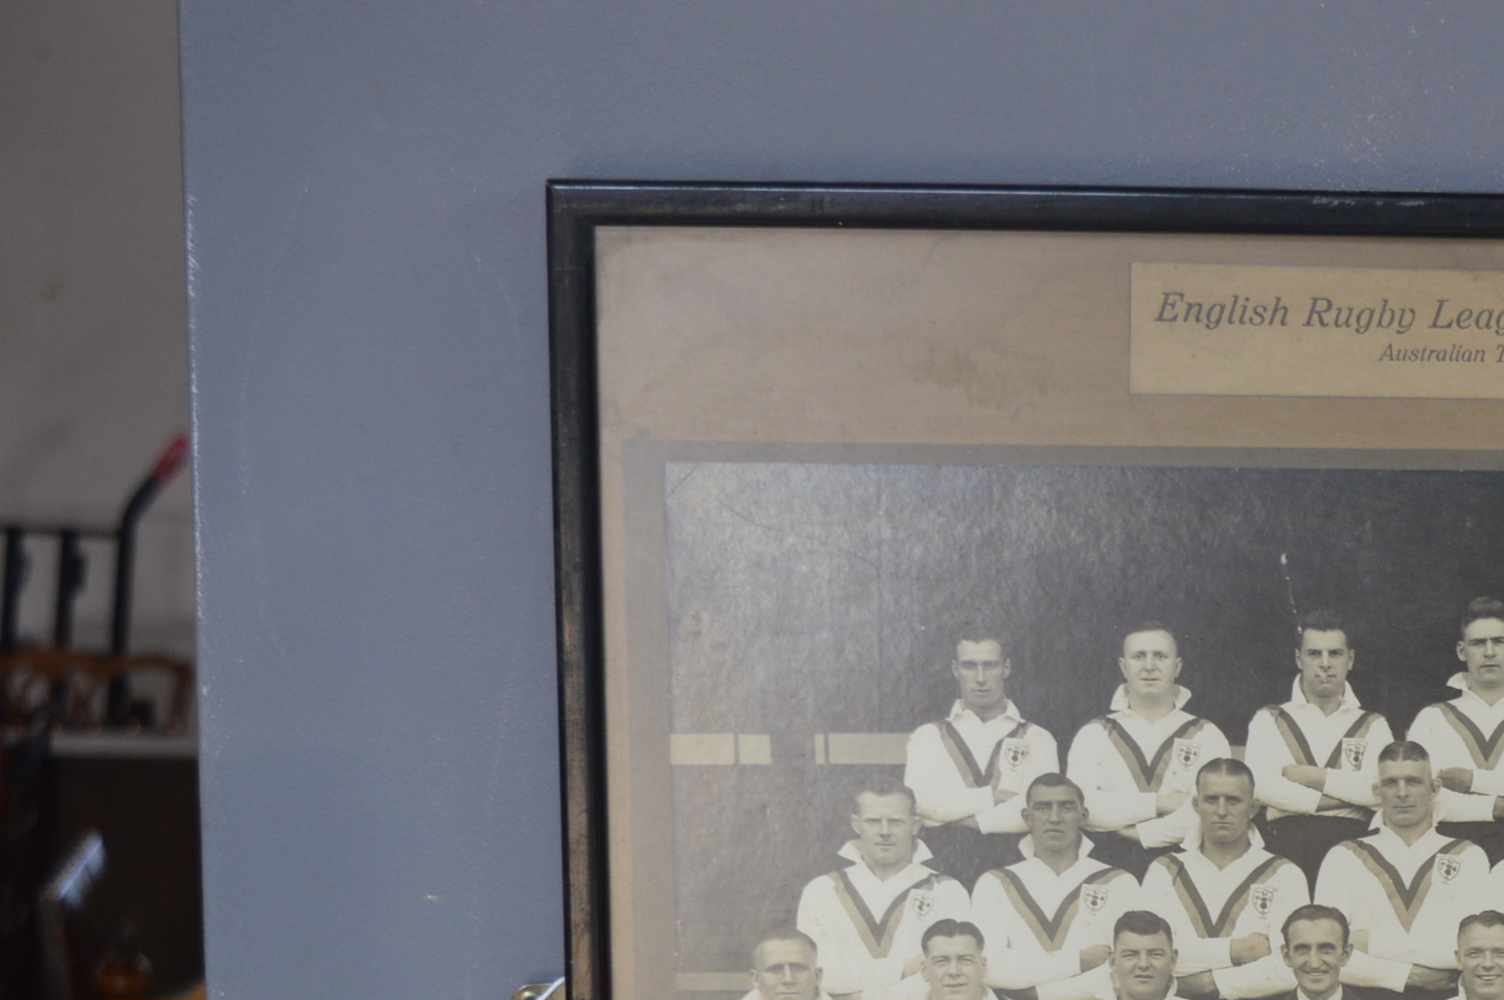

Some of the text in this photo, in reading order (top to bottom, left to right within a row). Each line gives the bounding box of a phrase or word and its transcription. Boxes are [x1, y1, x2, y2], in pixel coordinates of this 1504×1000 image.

[1154, 292, 1289, 330] English
[1302, 297, 1416, 334] Rugby
[1378, 343, 1486, 362] Australian
